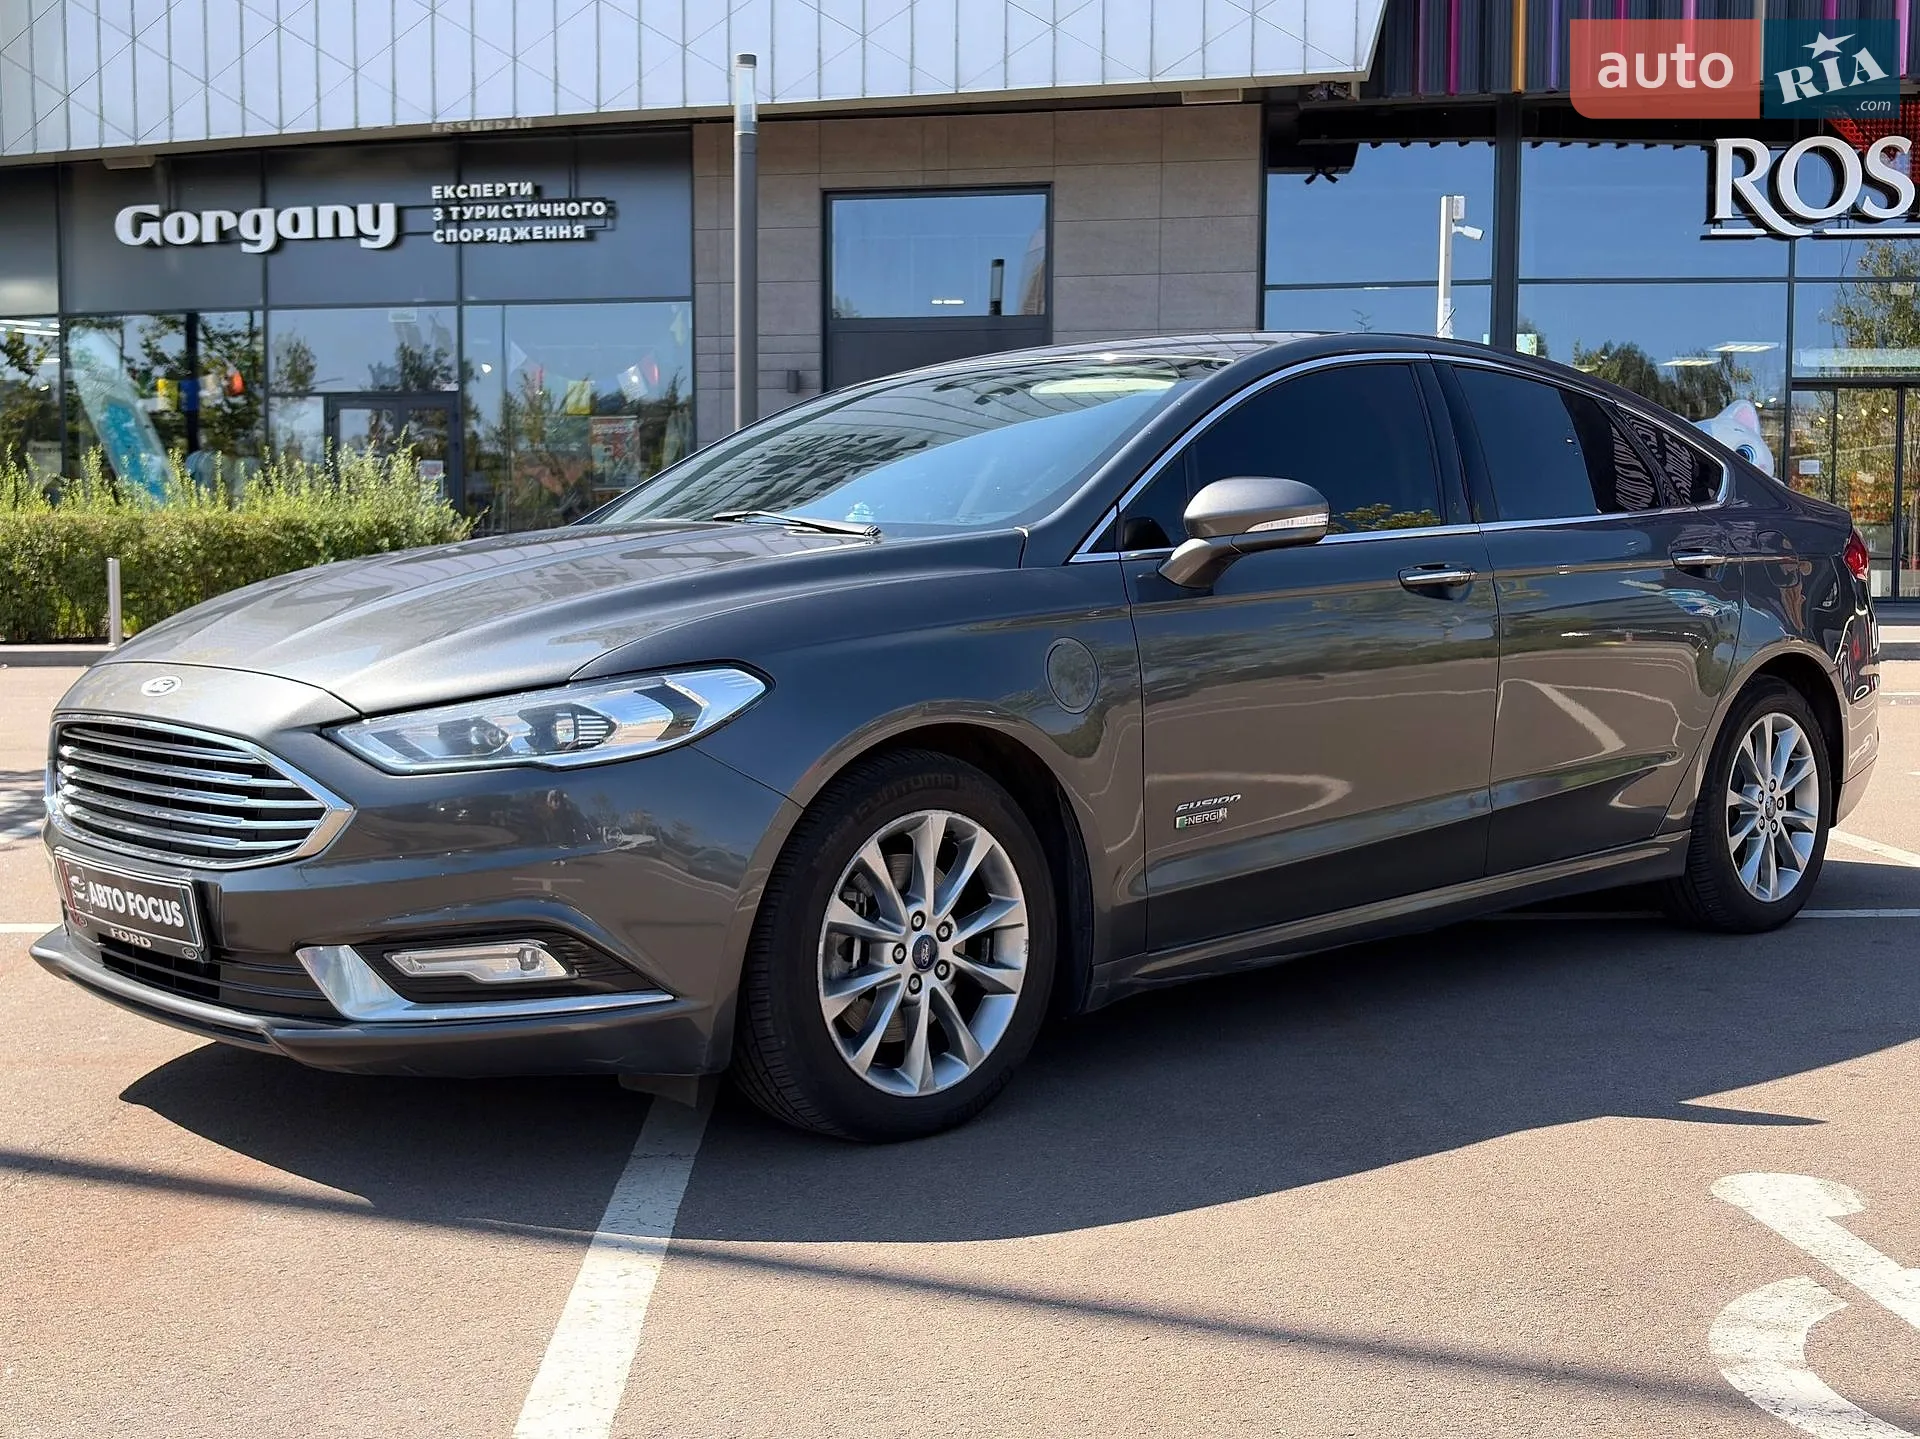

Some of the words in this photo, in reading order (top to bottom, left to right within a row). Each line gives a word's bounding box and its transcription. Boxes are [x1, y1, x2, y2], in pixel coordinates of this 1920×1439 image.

[431, 181, 534, 200] ЕКСПЕРТИ
[449, 201, 607, 221] ТУРИСТИЧНОГО
[114, 202, 398, 254] Gorgany
[432, 224, 587, 244] СПОРЯДЖЕННЯ
[126, 891, 185, 928] FOCUS
[111, 927, 153, 949] FORD
